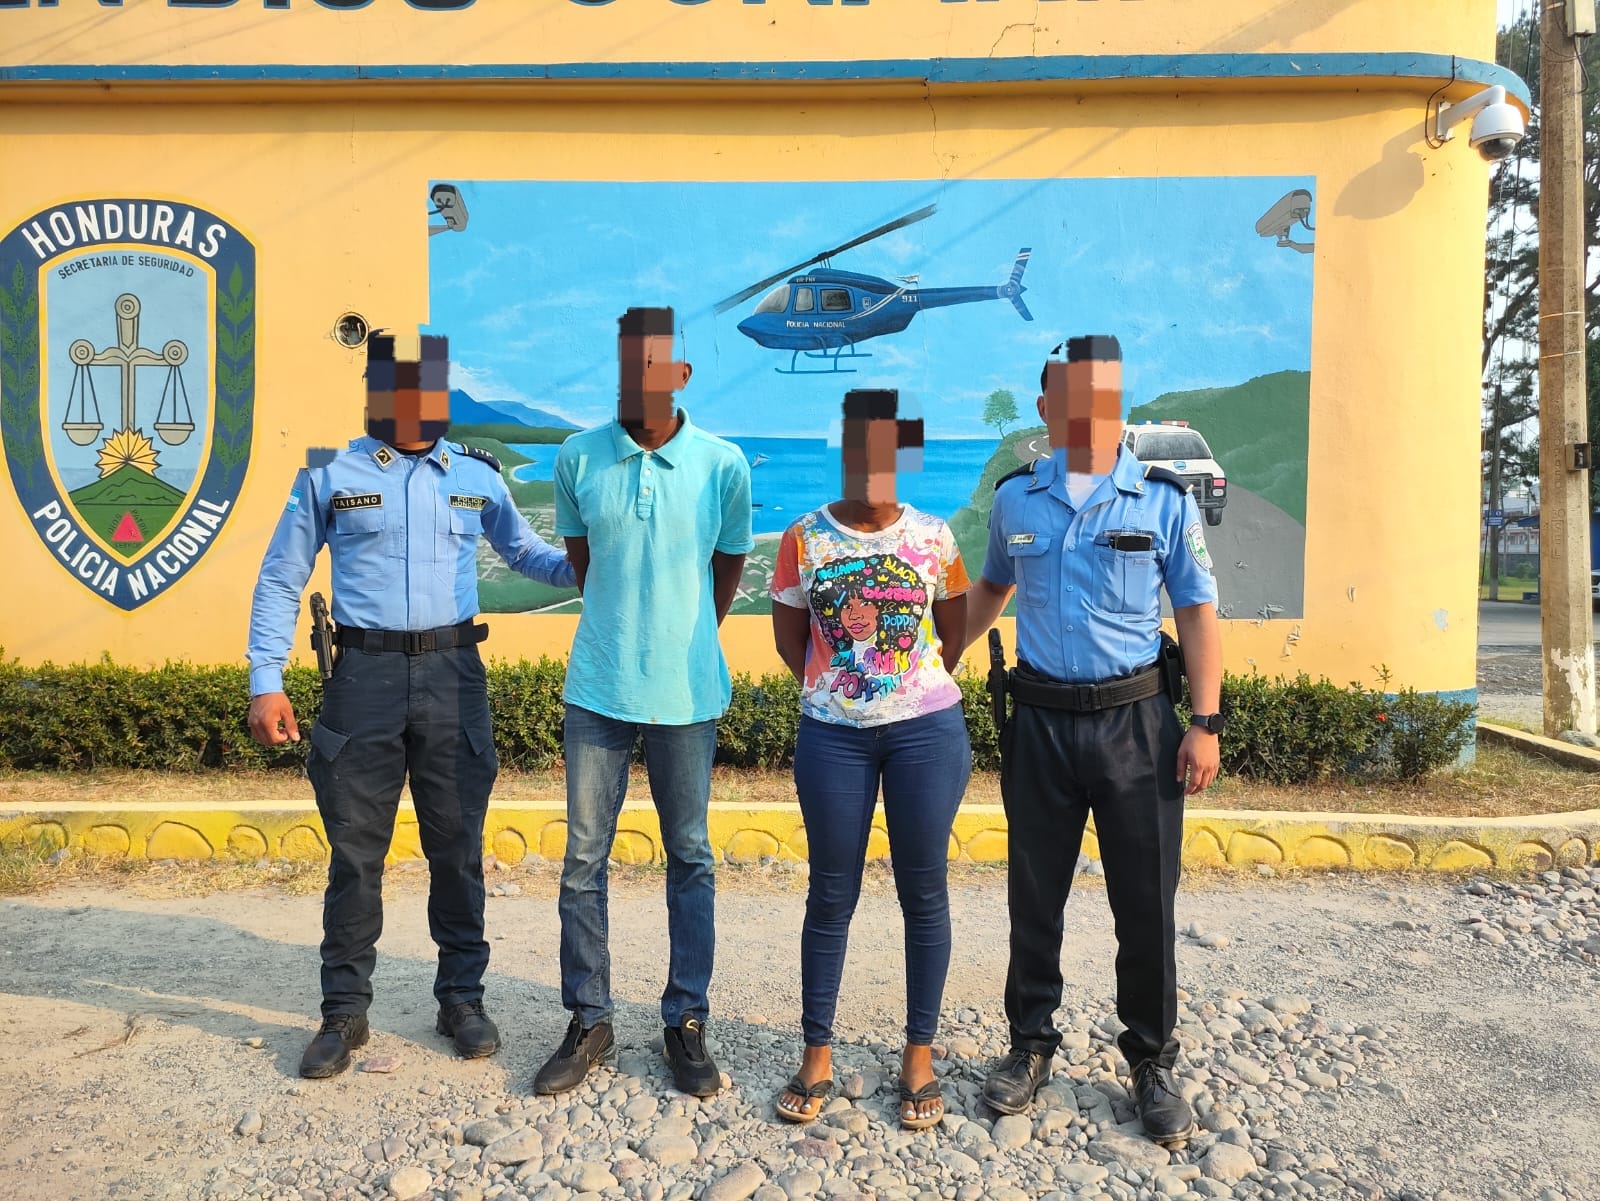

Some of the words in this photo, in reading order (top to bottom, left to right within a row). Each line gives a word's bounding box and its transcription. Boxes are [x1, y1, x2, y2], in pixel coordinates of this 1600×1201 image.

[21, 203, 227, 260] HONDURAS
[58, 255, 119, 279] SECRETARIA
[121, 255, 134, 266] DE
[138, 256, 194, 278] SEGURIDAD
[813, 321, 846, 329] NACIONAL
[33, 500, 119, 596] POLICIA
[127, 499, 230, 600] NACIONAL
